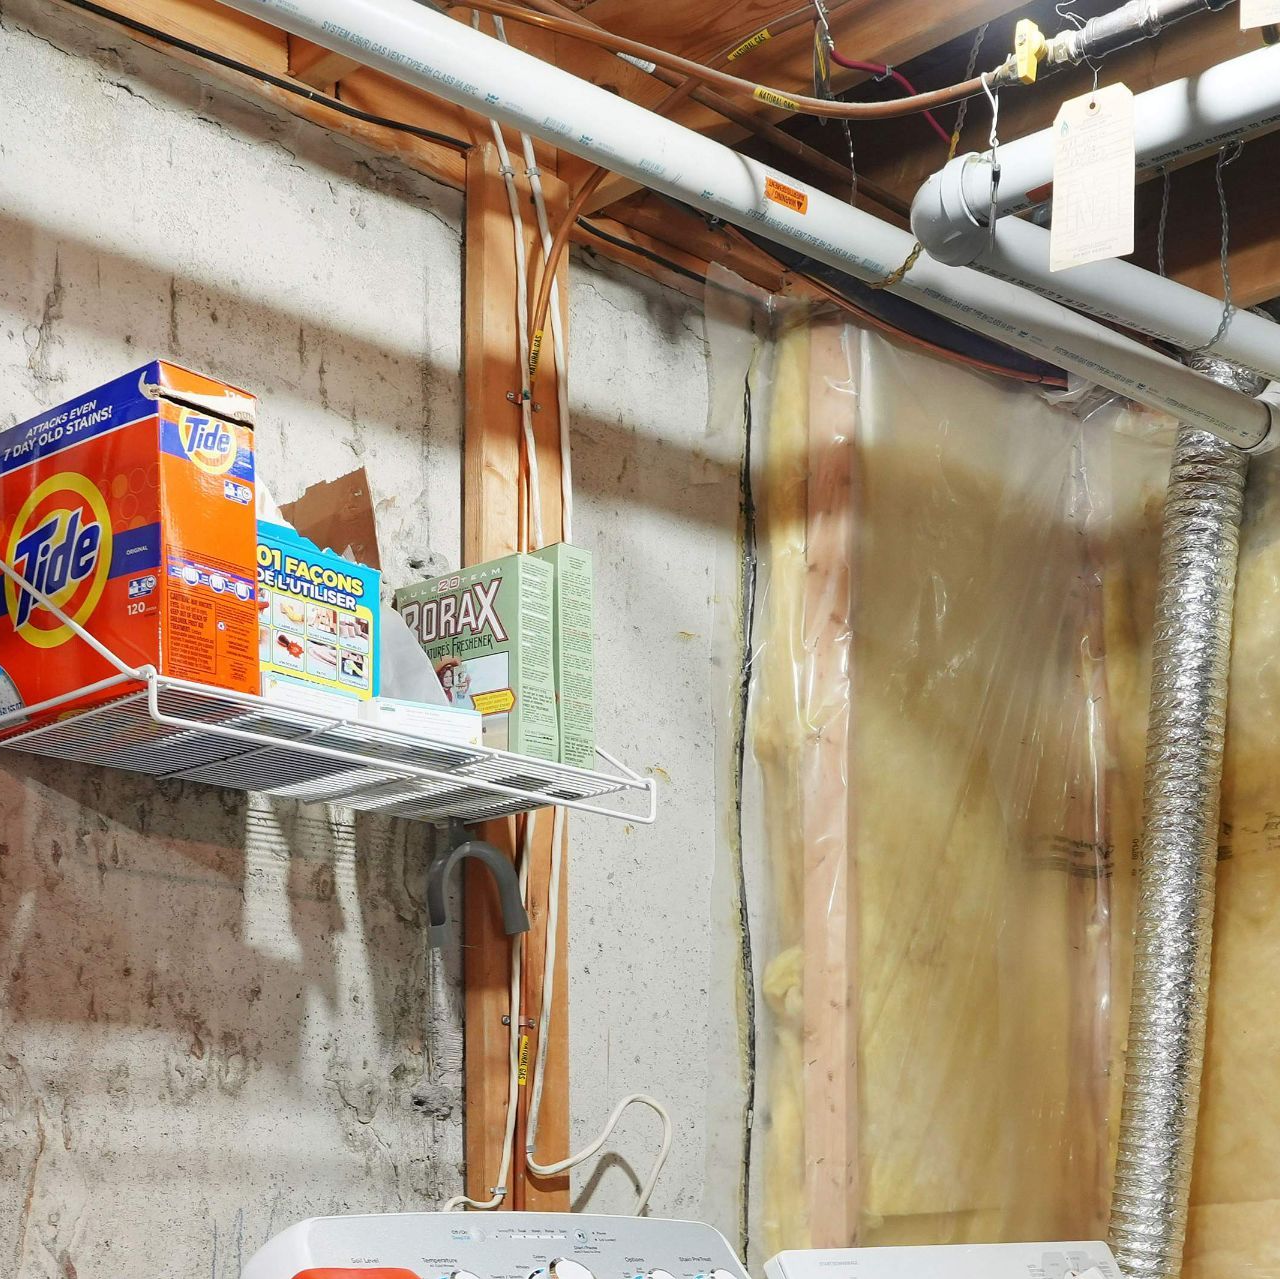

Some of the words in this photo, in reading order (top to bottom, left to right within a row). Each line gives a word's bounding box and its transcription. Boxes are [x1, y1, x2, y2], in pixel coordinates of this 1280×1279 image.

[754, 31, 767, 47] GAS
[320, 19, 350, 40] SYSTEM
[370, 41, 387, 56] GAS
[384, 47, 406, 64] VENT
[403, 56, 423, 71] TYPE
[421, 63, 433, 76] BH
[431, 68, 456, 86] CLASS
[533, 334, 543, 349] GAS
[25, 412, 68, 438] ATTACKS
[69, 399, 97, 421] EVEN
[3, 448, 11, 462] 7
[12, 438, 38, 457] DAY
[37, 426, 64, 448] OLD
[65, 405, 113, 436] STAINS!
[185, 415, 231, 453] Tide
[125, 545, 148, 556] ORIGINAL
[14, 506, 102, 632] Tide
[285, 555, 364, 597] FAÇONS
[277, 574, 357, 612] L'UTILISER
[437, 575, 460, 593] 20
[127, 601, 146, 616] 120
[451, 633, 493, 657] FRESHENER
[350, 1256, 363, 1265] Soil
[363, 1256, 380, 1265] Level
[421, 1256, 459, 1266] Temperature
